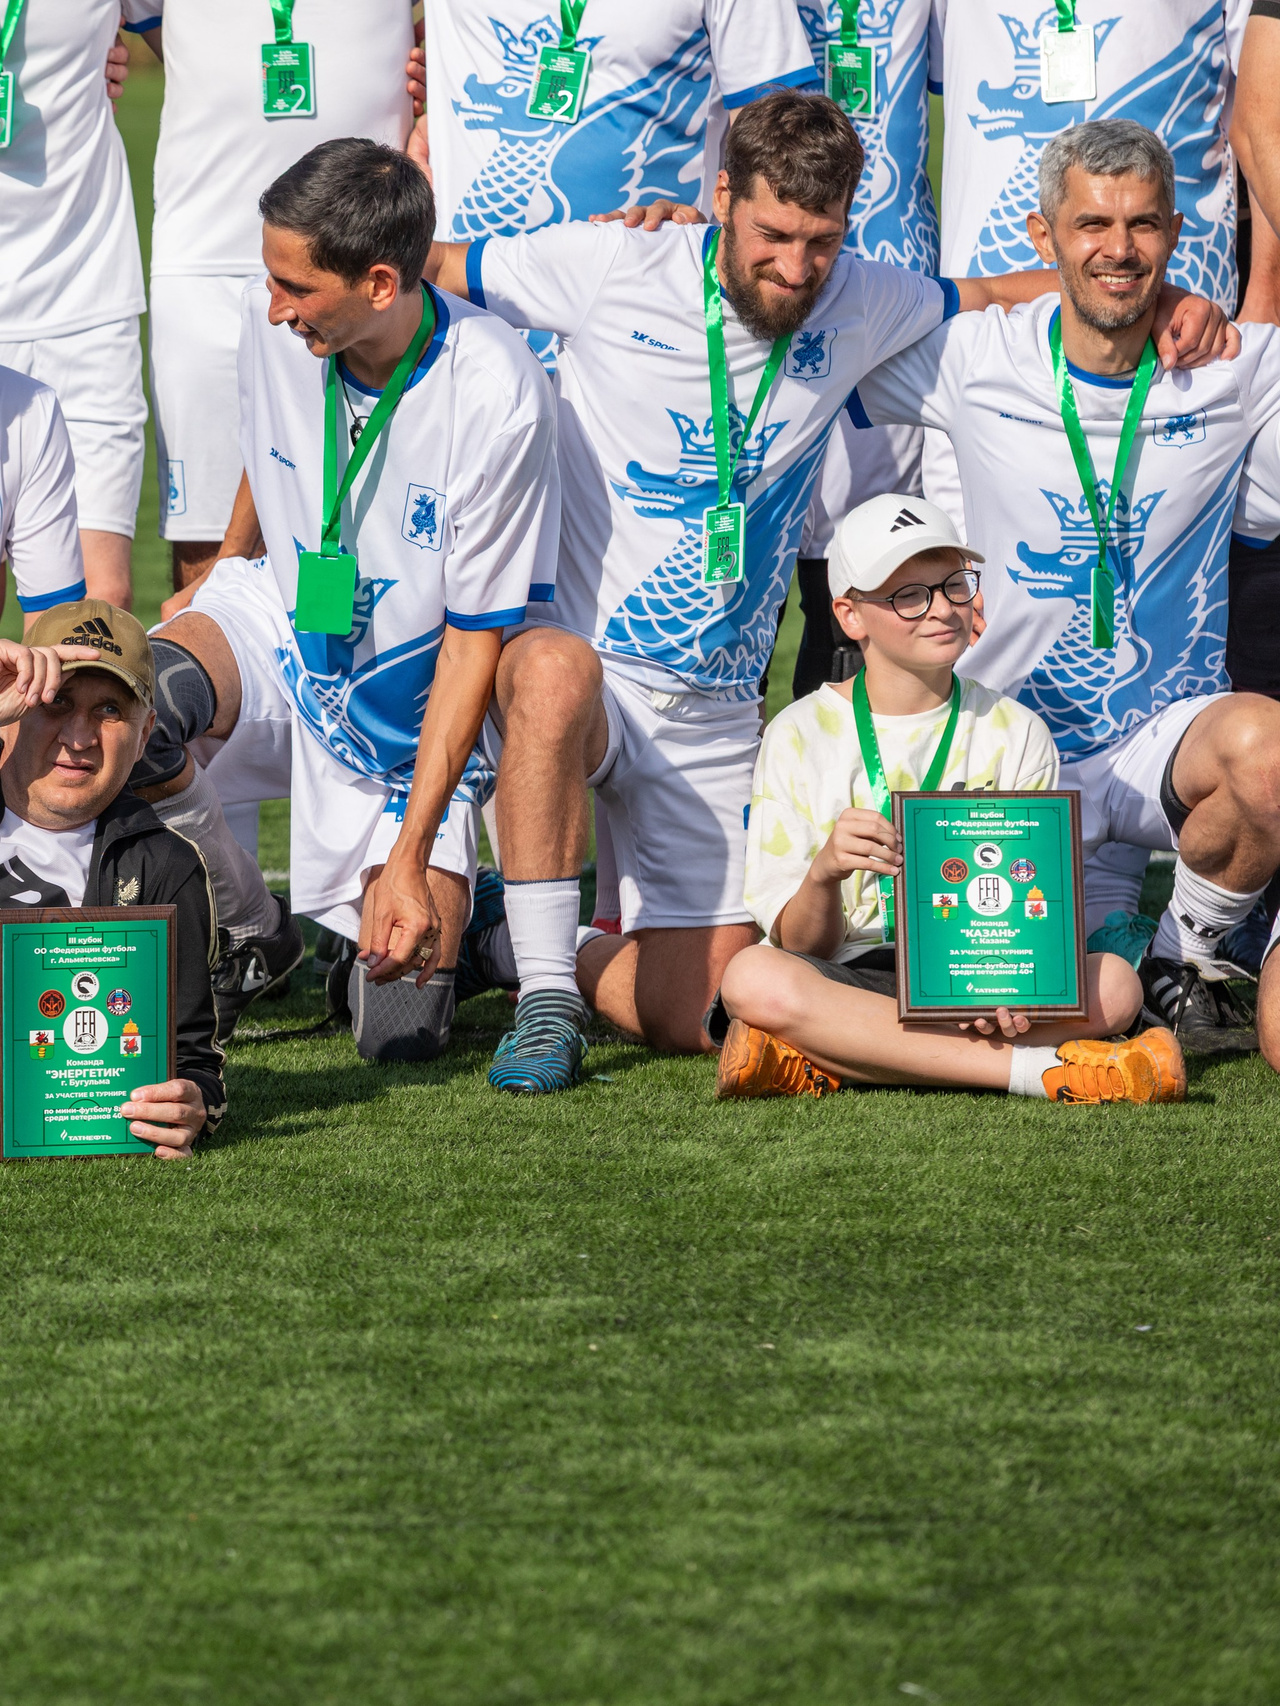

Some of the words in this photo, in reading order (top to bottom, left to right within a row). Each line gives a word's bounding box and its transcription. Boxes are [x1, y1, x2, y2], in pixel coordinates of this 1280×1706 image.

[290, 84, 308, 112] 2
[852, 88, 870, 117] 2
[553, 90, 573, 120] 2
[723, 551, 737, 582] 2
[61, 634, 122, 656] adidas
[951, 820, 1002, 828] «Федерации
[1004, 820, 1039, 828] футбола
[960, 929, 1020, 937] "КАЗАНЬ"
[78, 936, 102, 945] кубок
[102, 945, 136, 954] футбола
[46, 1067, 125, 1079] "ЭНЕРГЕТИК"
[69, 1079, 110, 1087] Бугульма
[55, 1106, 112, 1114] мини-футболу
